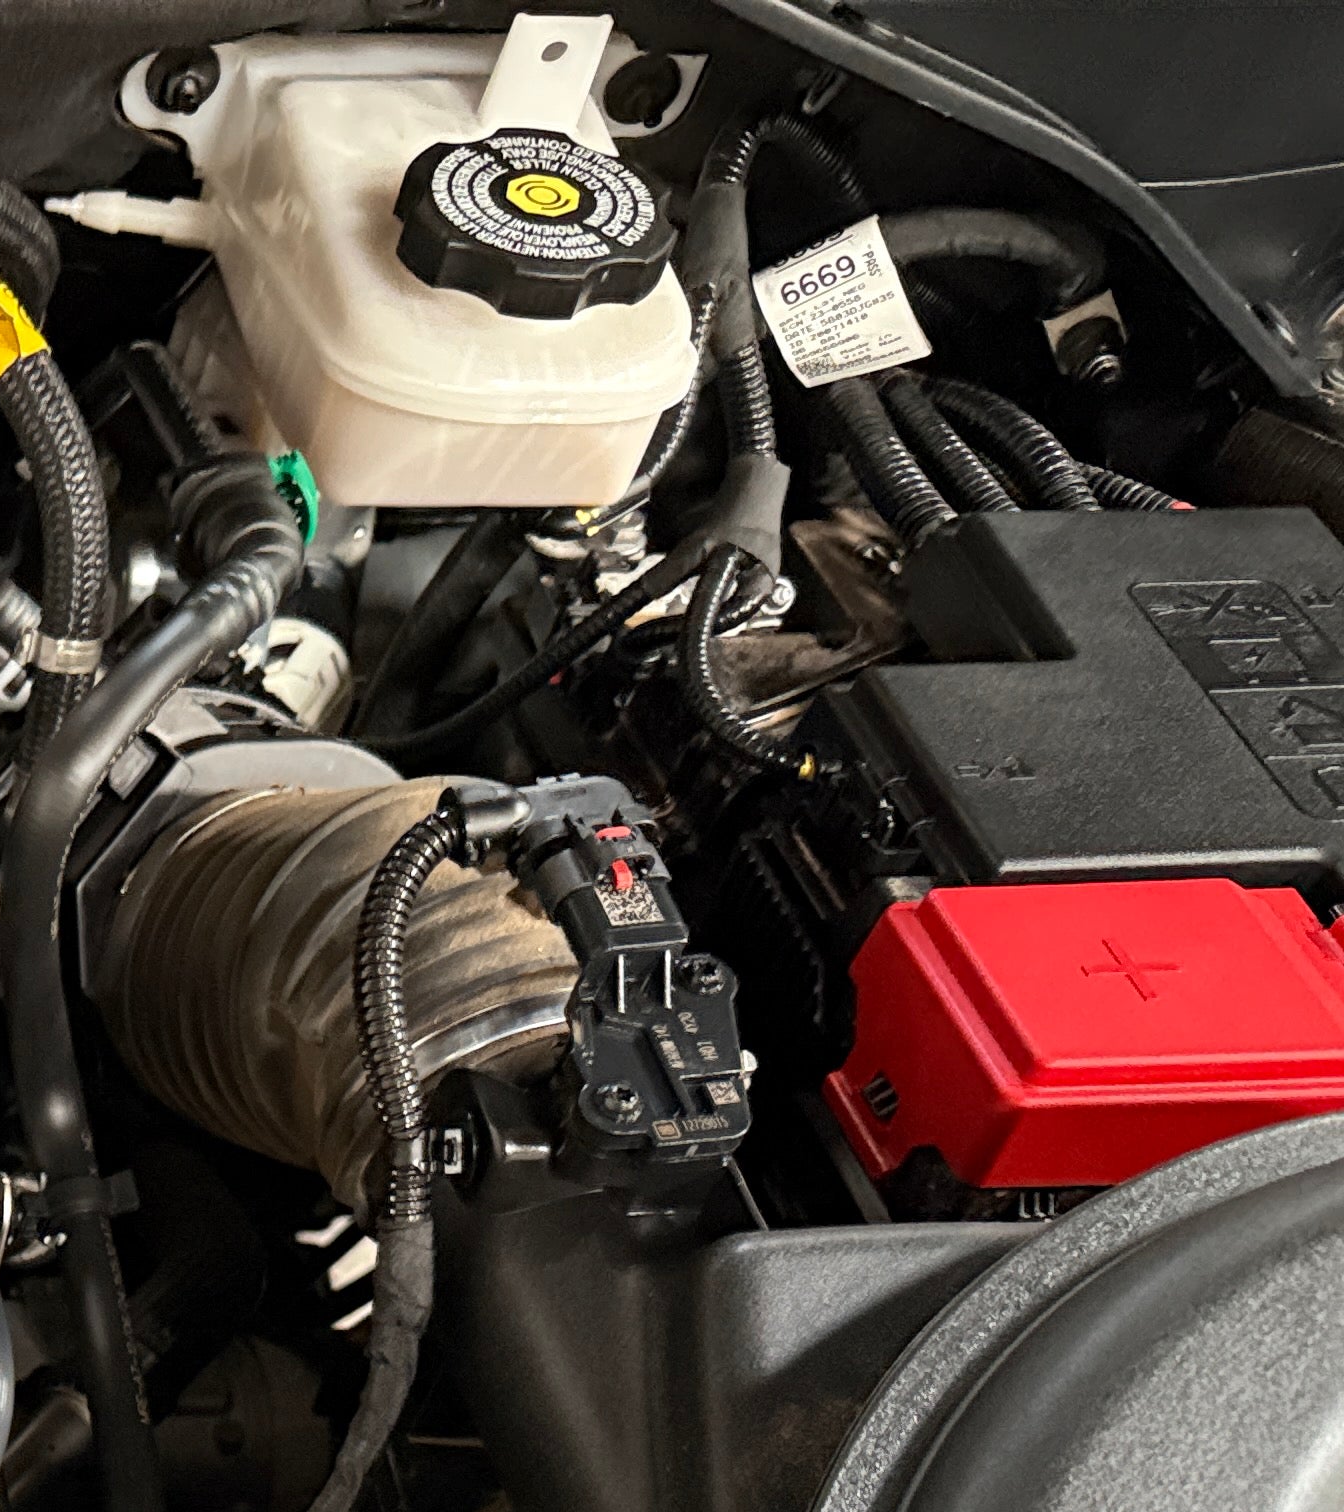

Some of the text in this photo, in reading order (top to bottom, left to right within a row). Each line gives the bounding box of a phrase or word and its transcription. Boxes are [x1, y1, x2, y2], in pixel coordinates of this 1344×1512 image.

[501, 146, 536, 159] ONLY
[572, 146, 624, 173] SEALED
[510, 157, 559, 172] FILLER
[781, 256, 856, 305] 6669
